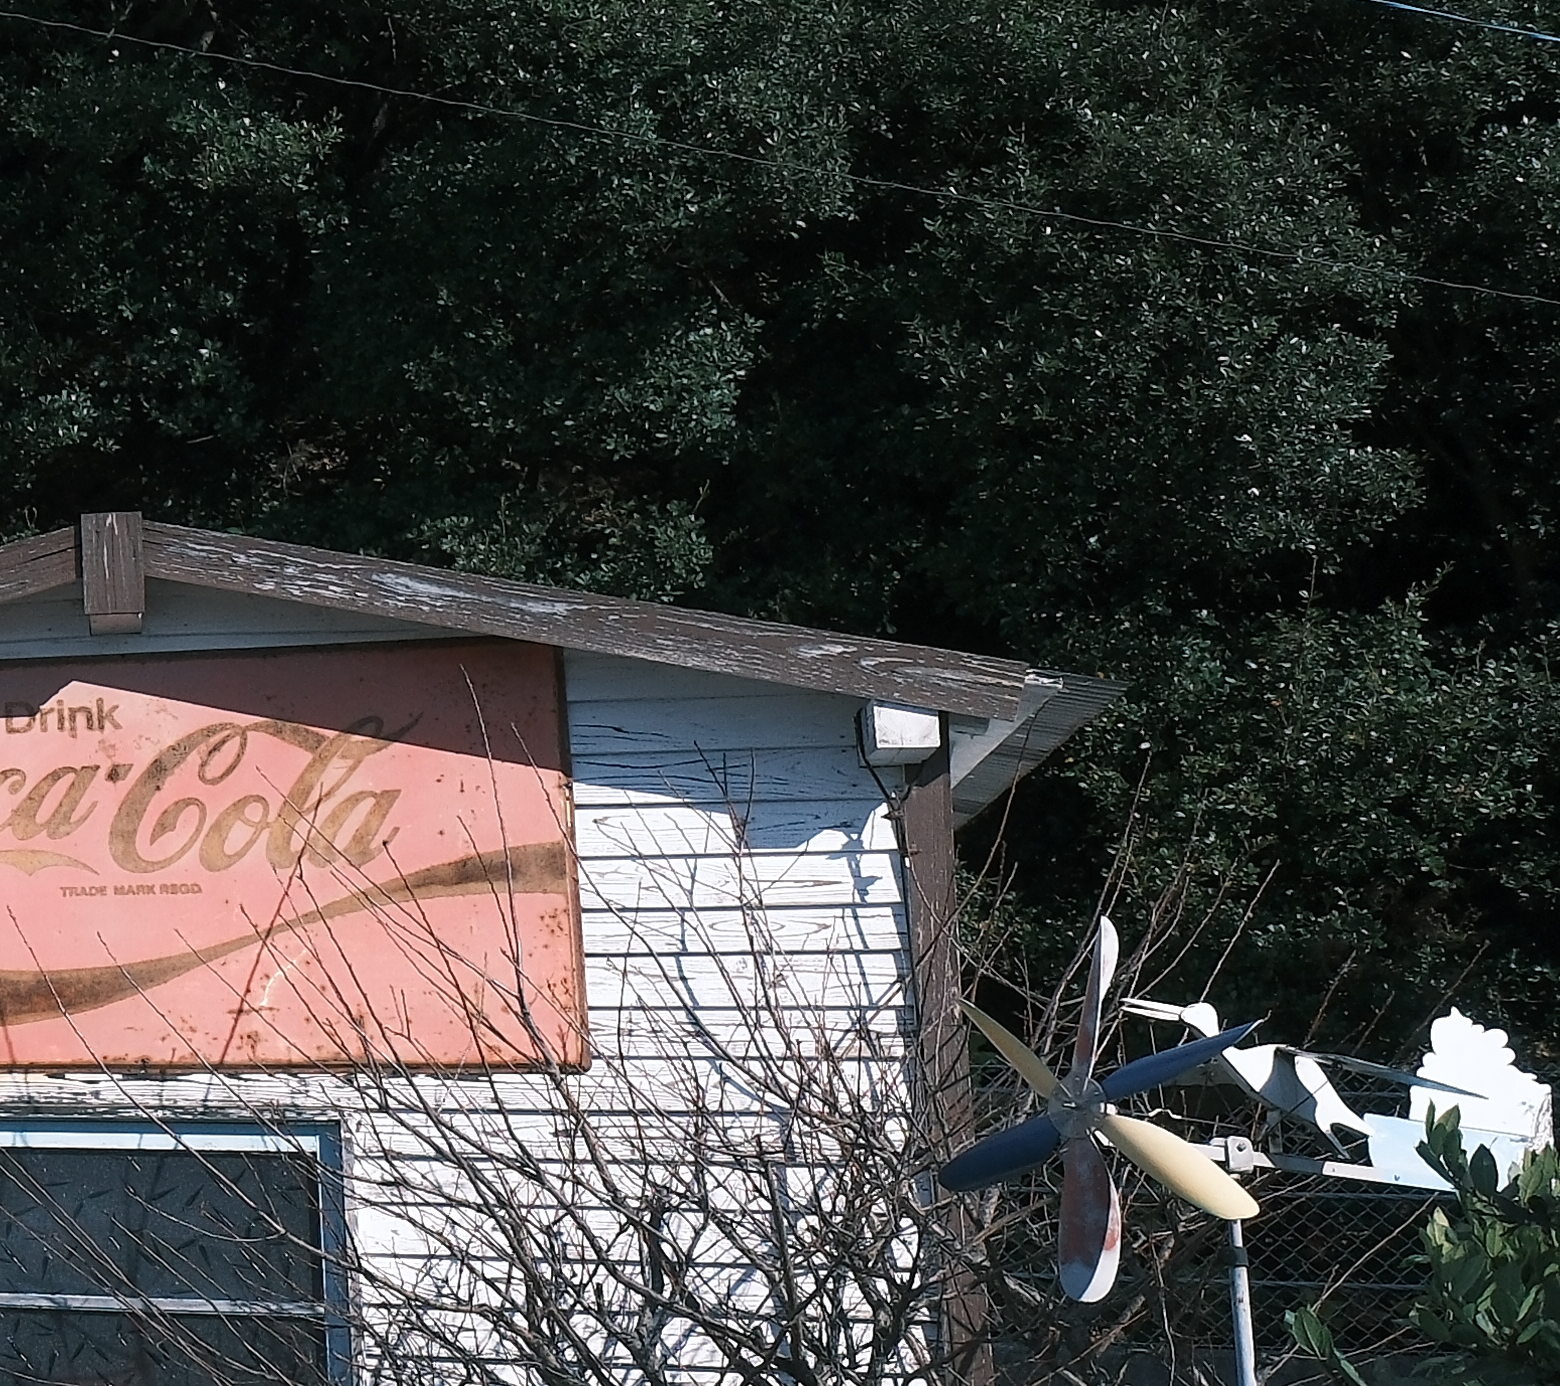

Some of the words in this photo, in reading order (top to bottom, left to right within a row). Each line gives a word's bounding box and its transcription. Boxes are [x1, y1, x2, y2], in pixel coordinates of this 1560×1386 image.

[5, 697, 124, 739] Drink
[60, 886, 107, 898] TRADE
[113, 884, 156, 896] MARK
